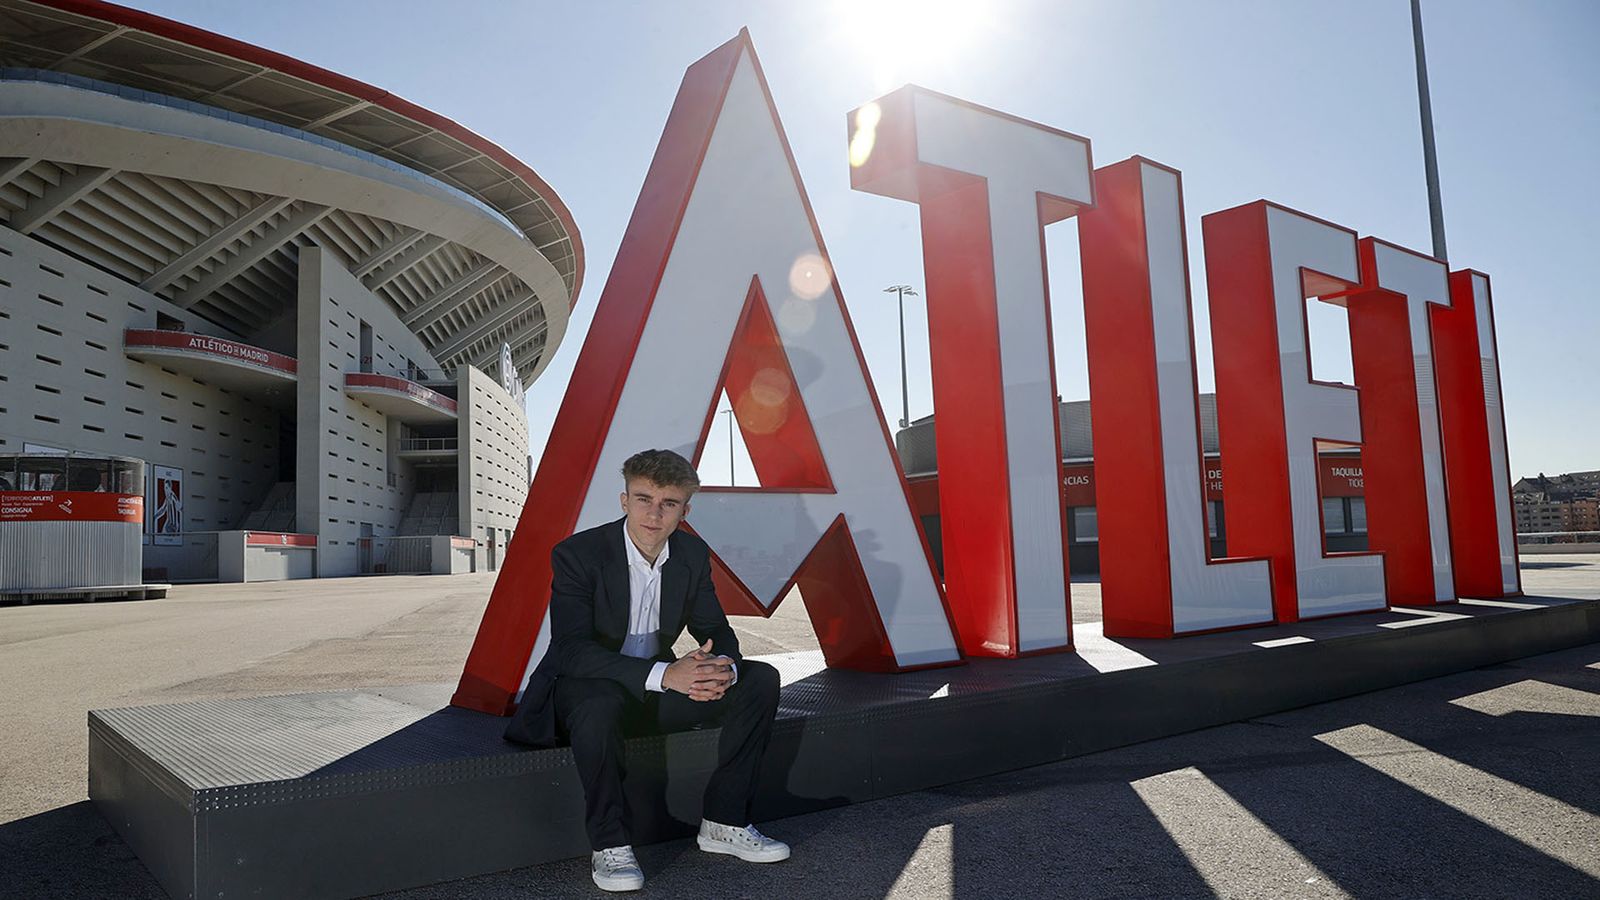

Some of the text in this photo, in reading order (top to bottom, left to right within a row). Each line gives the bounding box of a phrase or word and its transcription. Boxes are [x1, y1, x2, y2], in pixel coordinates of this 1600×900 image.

[189, 338, 233, 354] ATLÉTICO
[240, 348, 269, 363] MADRID
[452, 27, 1522, 716] ATLETI
